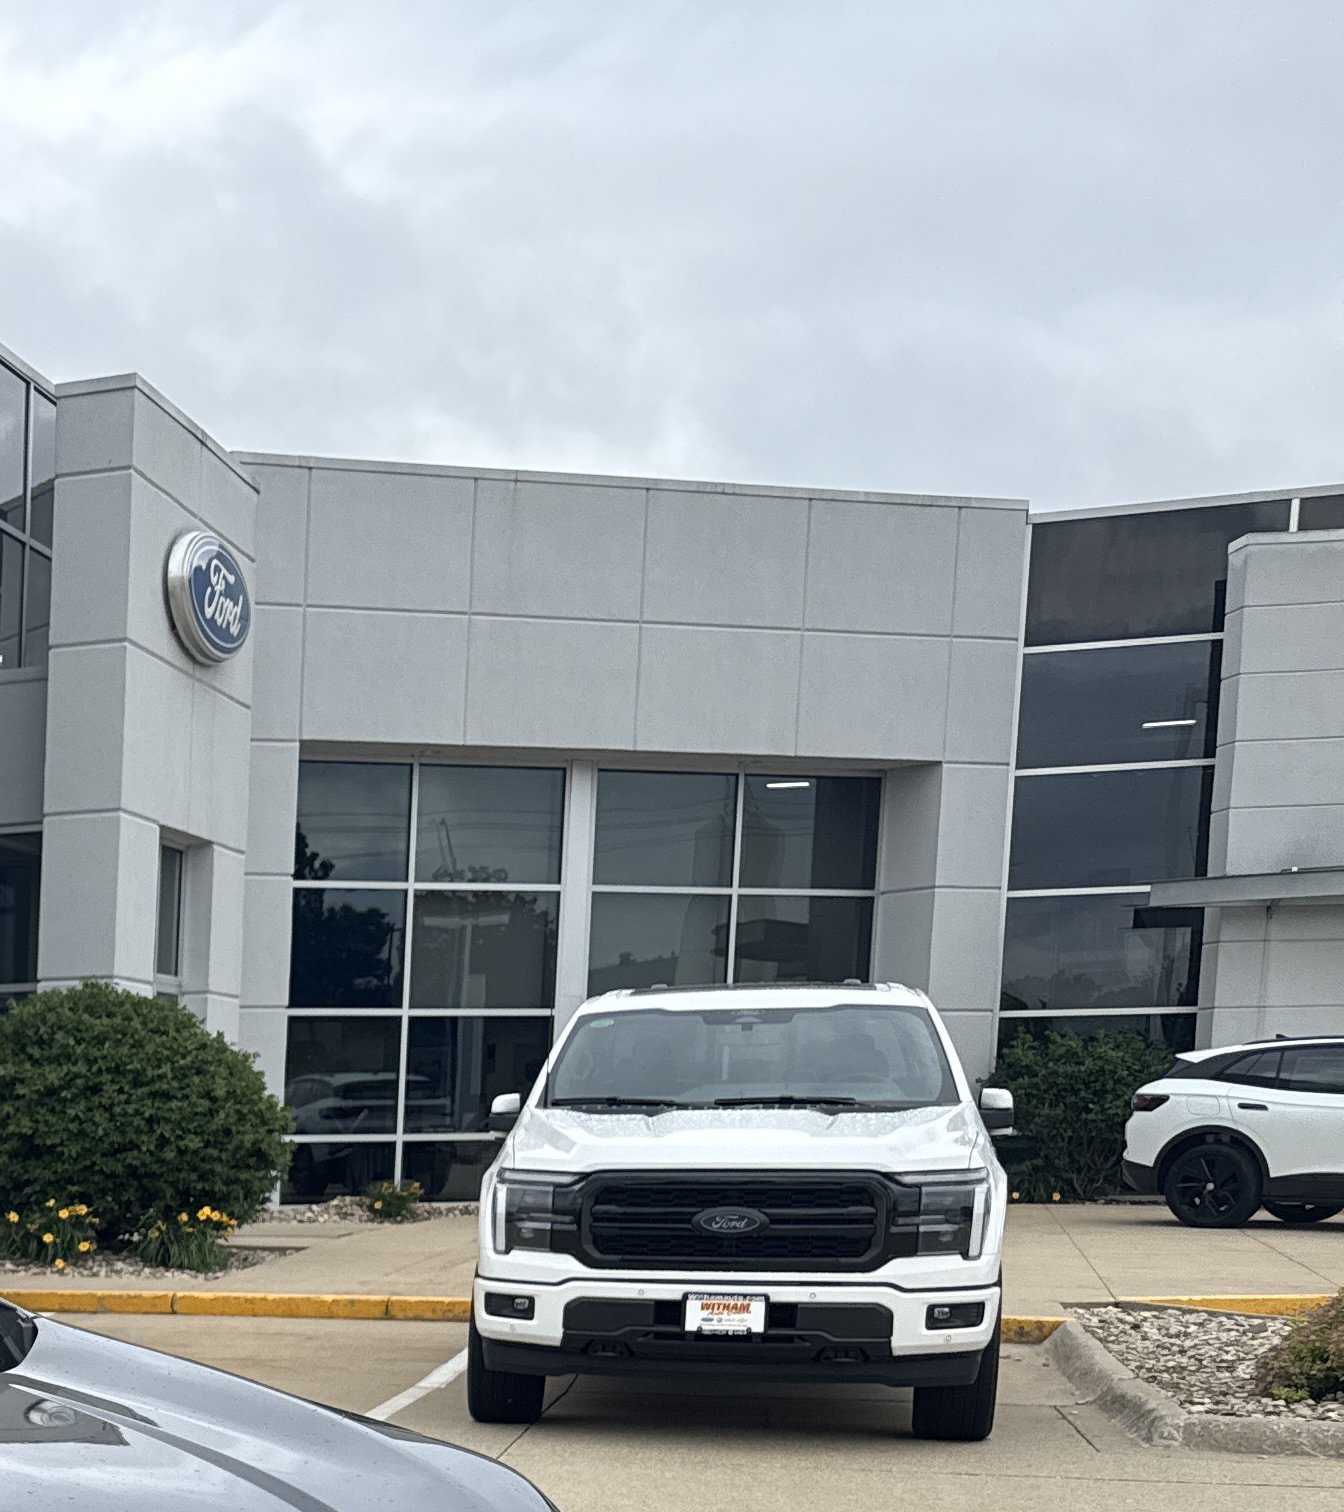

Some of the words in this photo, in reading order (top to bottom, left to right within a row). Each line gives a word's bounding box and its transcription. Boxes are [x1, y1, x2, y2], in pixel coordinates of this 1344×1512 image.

[204, 558, 244, 639] Ford
[712, 1215, 749, 1229] Ford
[701, 1301, 751, 1313] WITHAM
